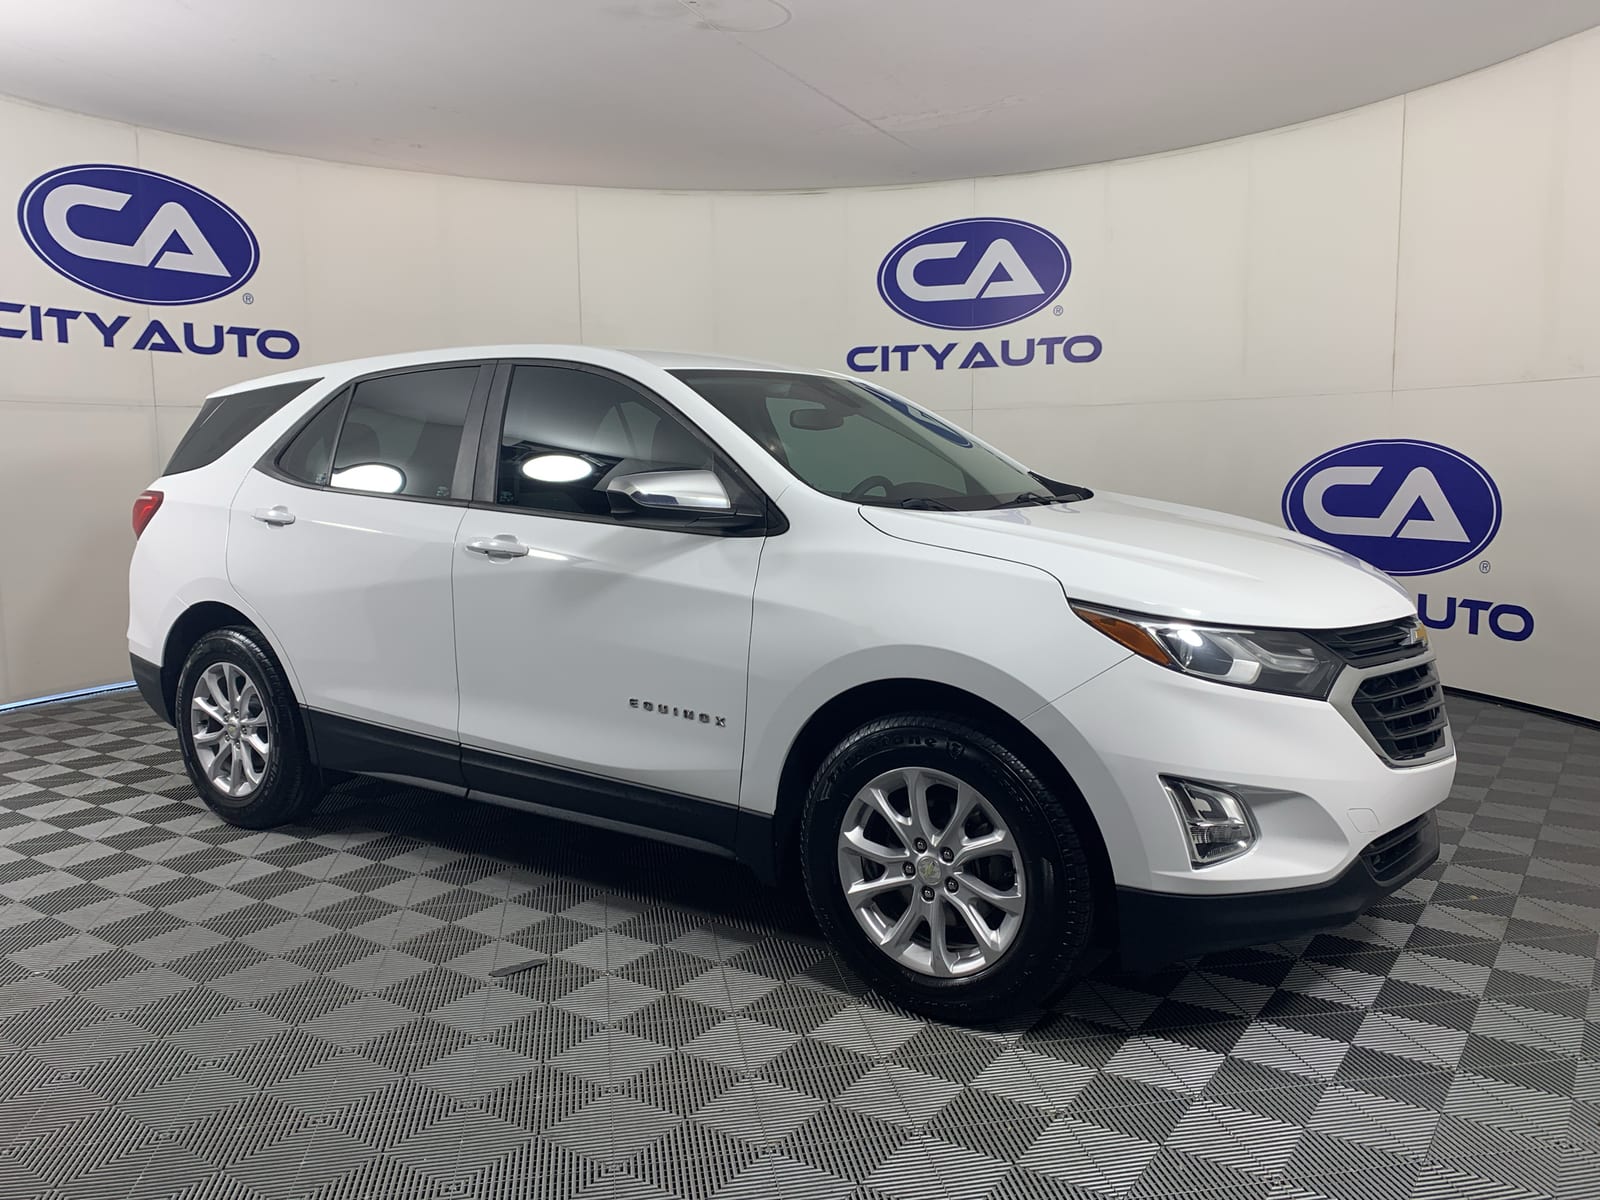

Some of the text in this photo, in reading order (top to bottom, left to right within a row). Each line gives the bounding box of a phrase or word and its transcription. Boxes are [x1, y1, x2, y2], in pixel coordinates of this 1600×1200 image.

[42, 183, 232, 278] CA
[896, 238, 1046, 302] CA
[0, 301, 300, 360] CITY AUTO
[846, 335, 1103, 373] CITY AUTO
[1302, 466, 1471, 543] CA
[1417, 593, 1534, 642] UTO
[628, 698, 727, 728] EQUINOX
